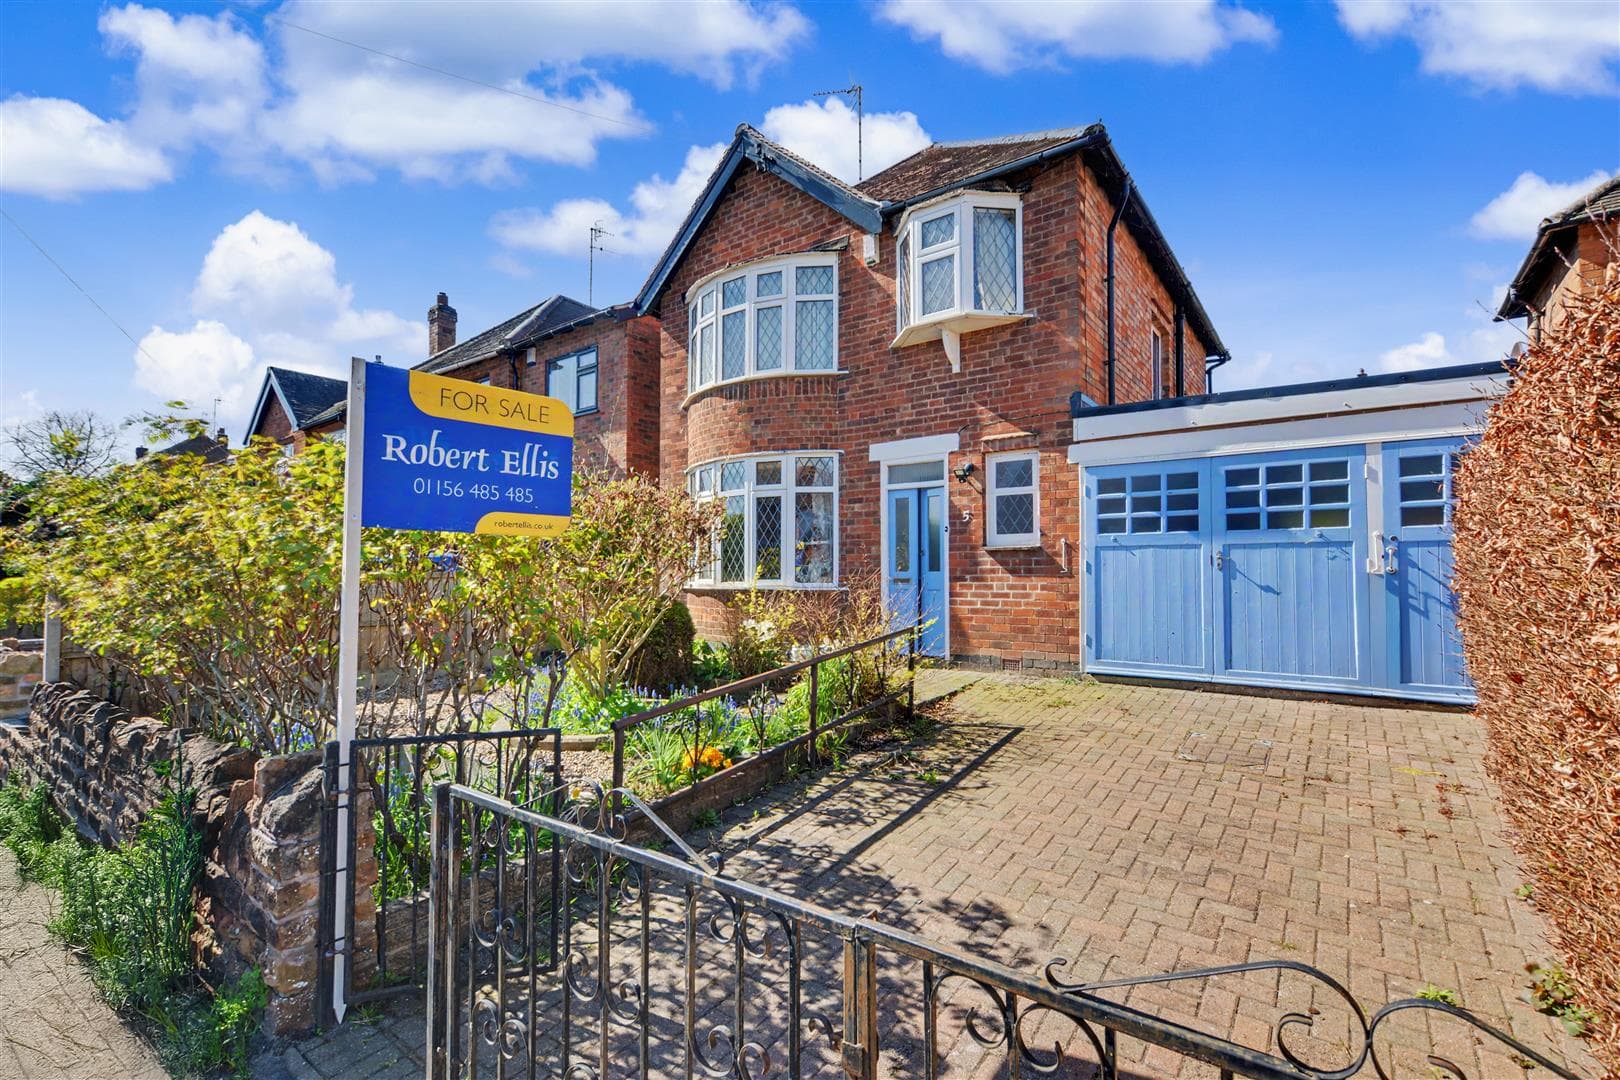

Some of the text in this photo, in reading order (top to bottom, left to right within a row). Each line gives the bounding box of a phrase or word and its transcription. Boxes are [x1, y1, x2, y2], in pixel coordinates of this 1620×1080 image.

[440, 388, 550, 424] FOR SALE
[381, 429, 559, 480] Robert Ellis
[413, 477, 534, 503] 01156 485 485
[494, 520, 553, 530] robertellis.co.uk
[962, 510, 970, 522] 5
